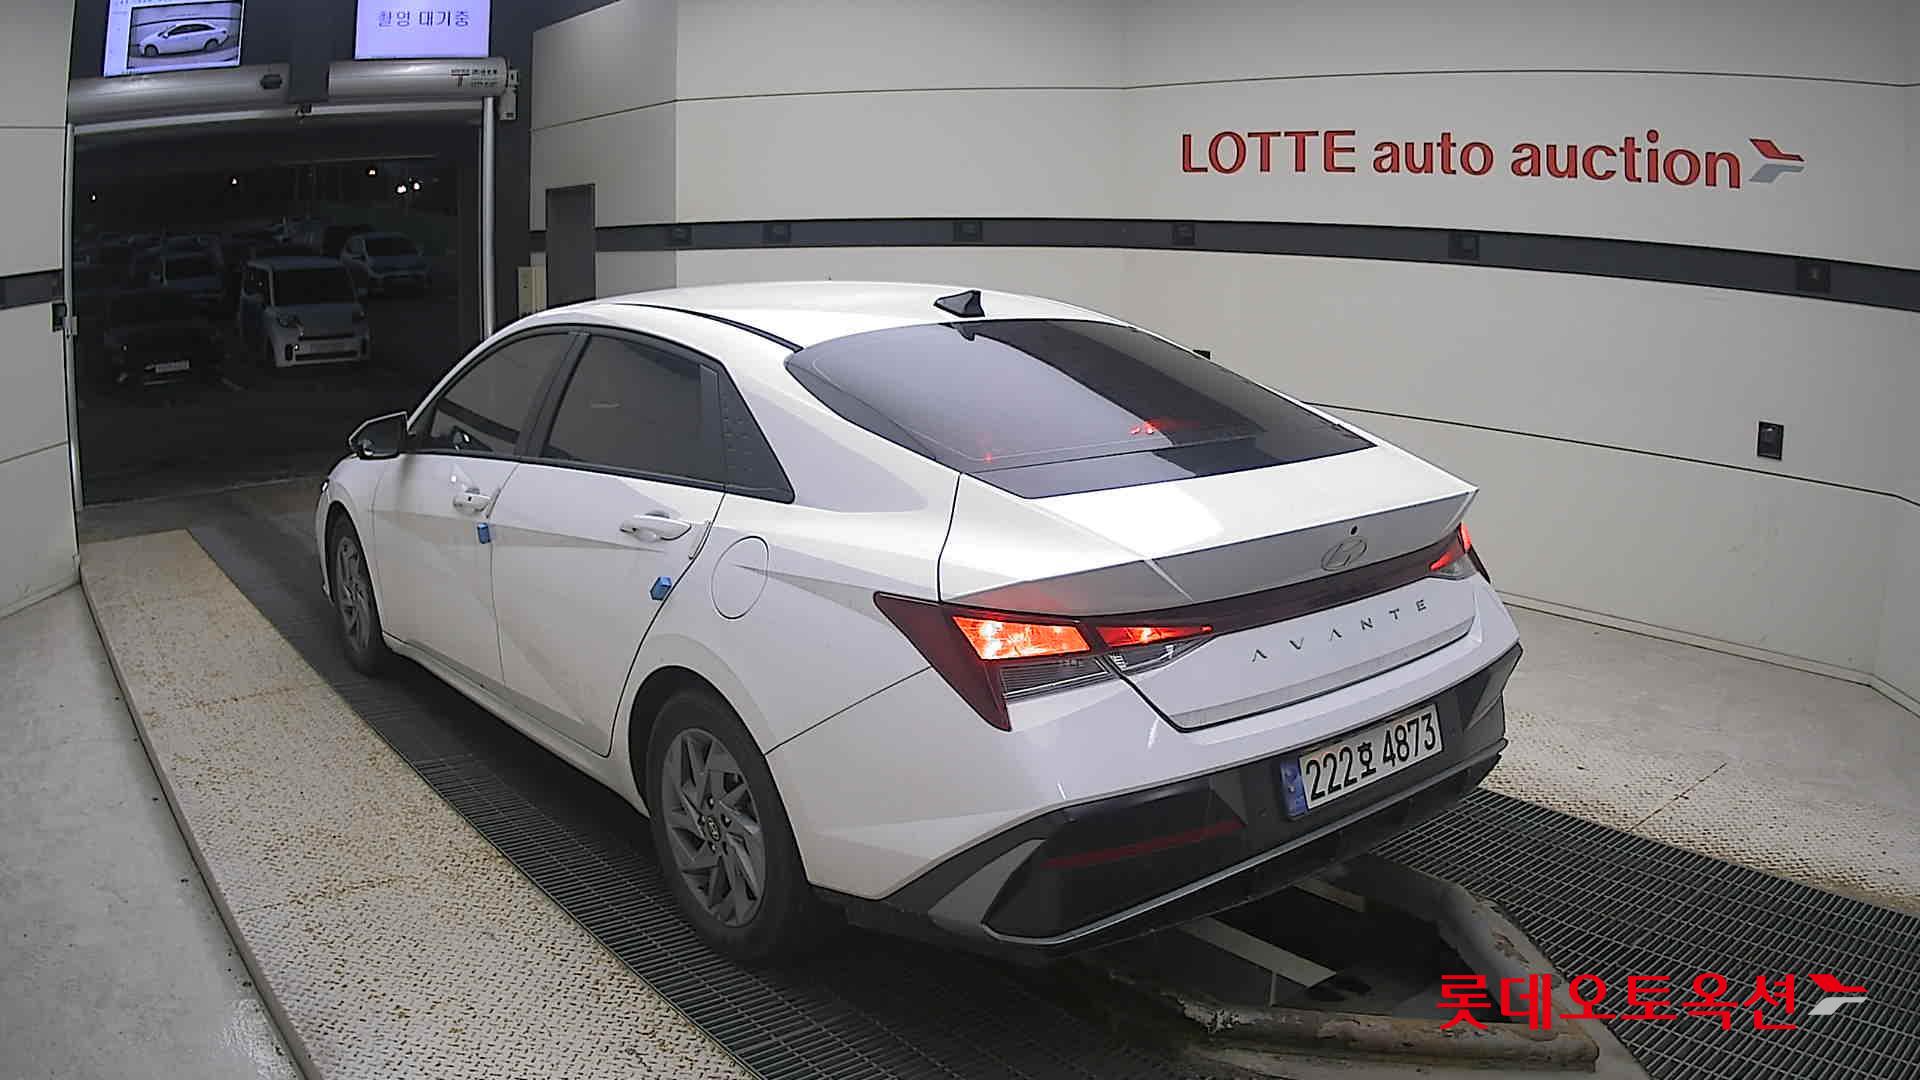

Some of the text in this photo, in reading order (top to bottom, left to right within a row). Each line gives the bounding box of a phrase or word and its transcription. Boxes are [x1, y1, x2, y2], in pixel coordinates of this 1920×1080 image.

[418, 10, 470, 27] 대기중
[1182, 129, 1741, 189] LOTTE auto auction
[1252, 599, 1427, 662] AVANTE
[1305, 712, 1436, 801] 222호 4873
